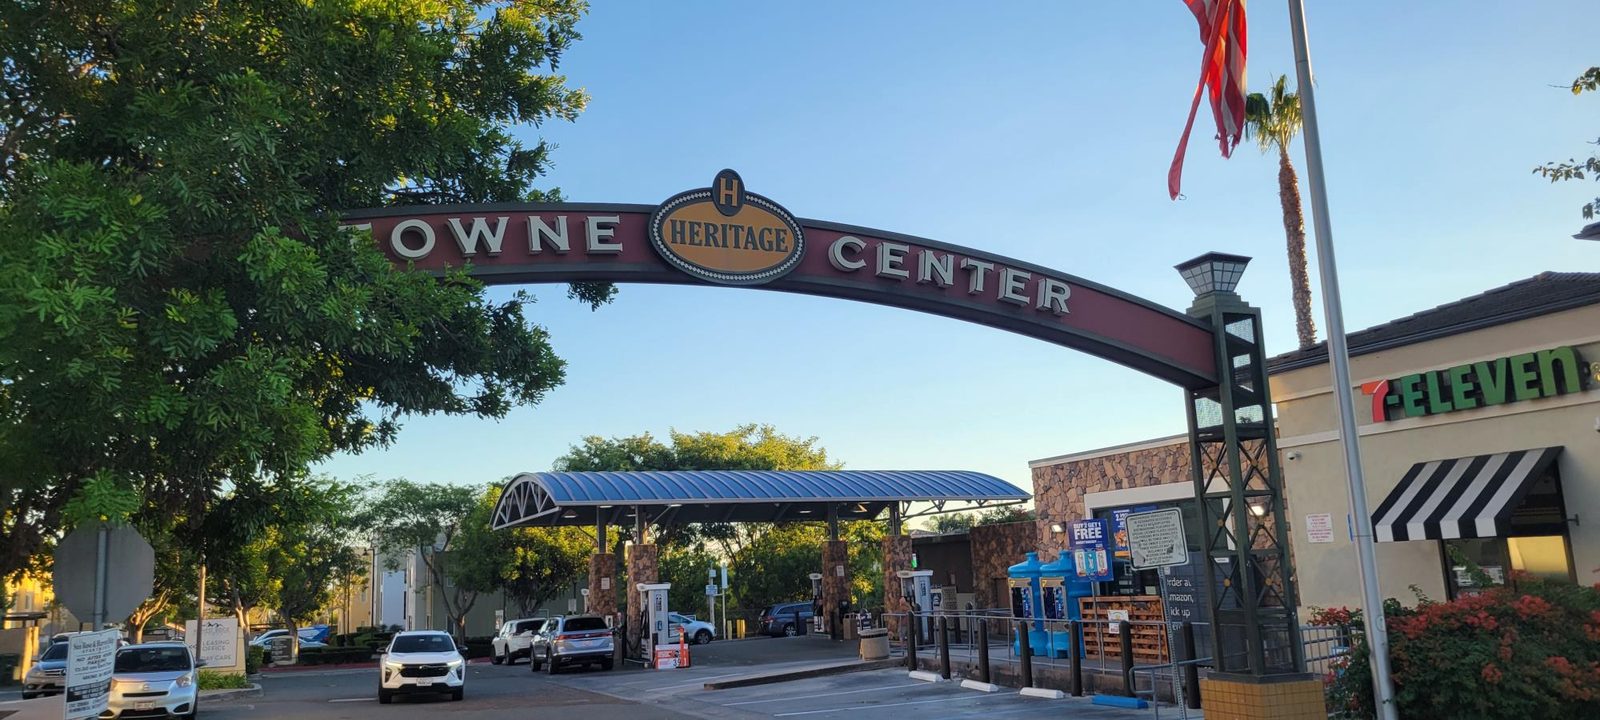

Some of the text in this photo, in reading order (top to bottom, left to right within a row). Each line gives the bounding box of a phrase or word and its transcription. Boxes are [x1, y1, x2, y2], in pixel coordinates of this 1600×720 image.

[719, 177, 738, 207] H
[670, 219, 789, 253] HERITAGE
[828, 236, 1071, 316] CENTER
[1074, 527, 1102, 540] FREE
[1166, 577, 1182, 587] rder
[1169, 593, 1194, 604] mazon,
[1170, 606, 1180, 616] ick
